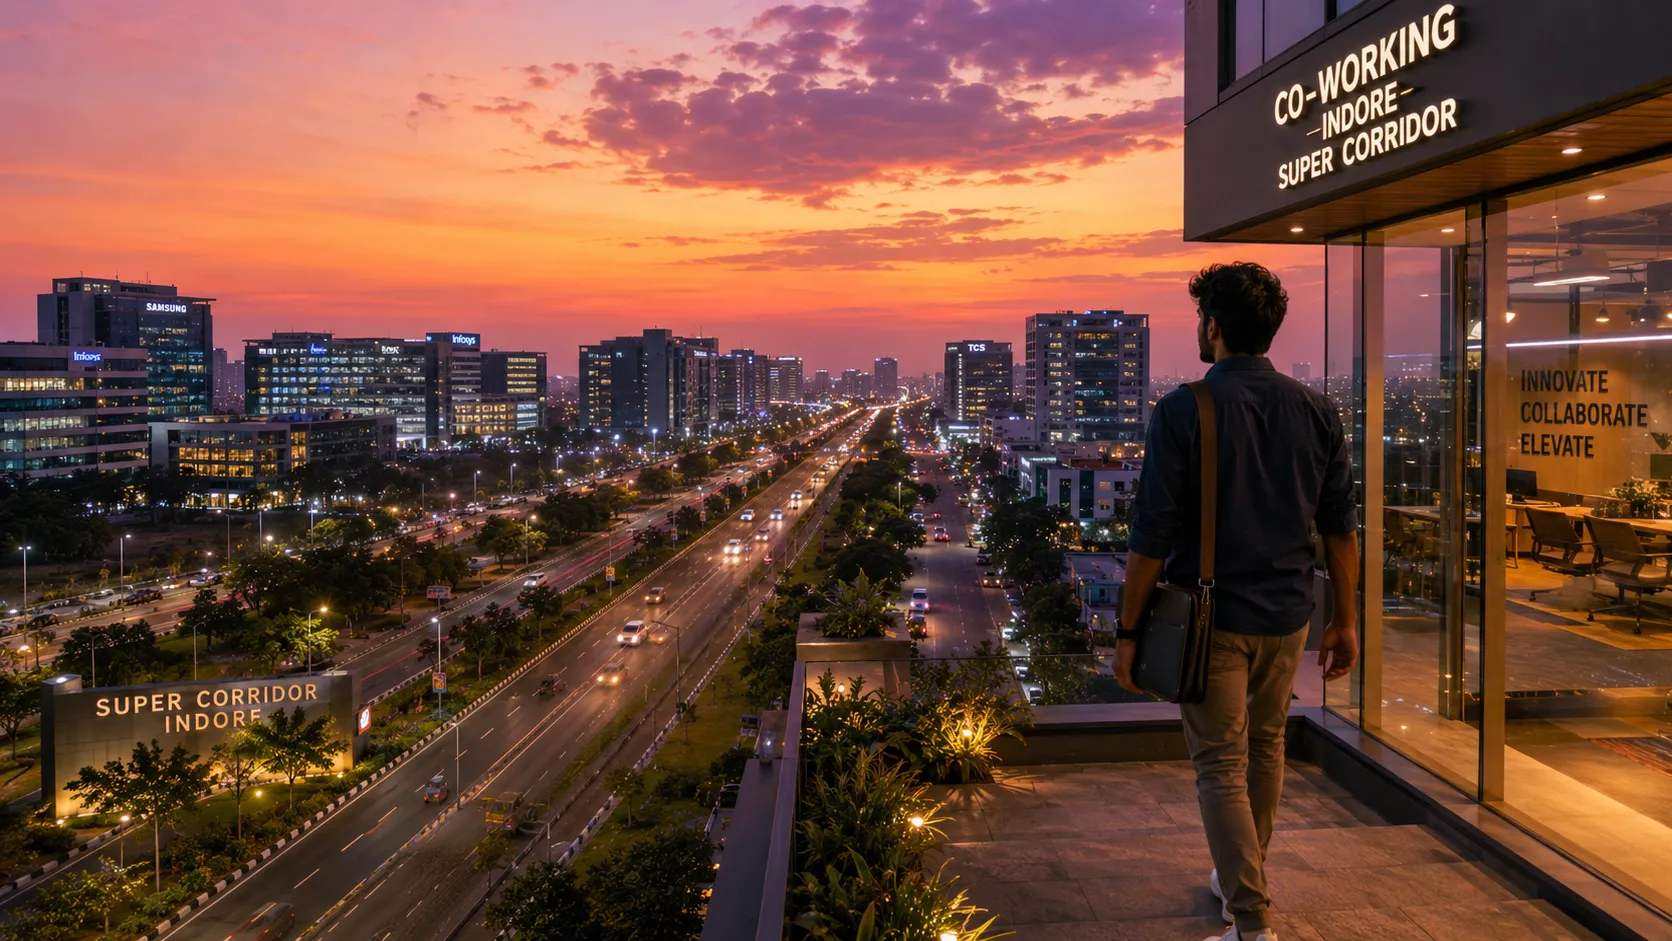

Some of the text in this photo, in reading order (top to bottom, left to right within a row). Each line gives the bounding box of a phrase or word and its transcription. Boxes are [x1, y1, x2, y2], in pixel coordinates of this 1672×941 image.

[1274, 4, 1456, 126] CO-WORKING
[1278, 98, 1457, 190] SUPER CORRIDOR
[146, 303, 187, 313] SAMSUNG
[451, 334, 476, 346] Infosys
[967, 344, 986, 352] TCS
[1521, 369, 1608, 393] INNOVATE
[1521, 401, 1648, 427] COLLABORATE
[1521, 433, 1594, 458] ELEVATE
[96, 683, 318, 717] SUPER CORRIDOR
